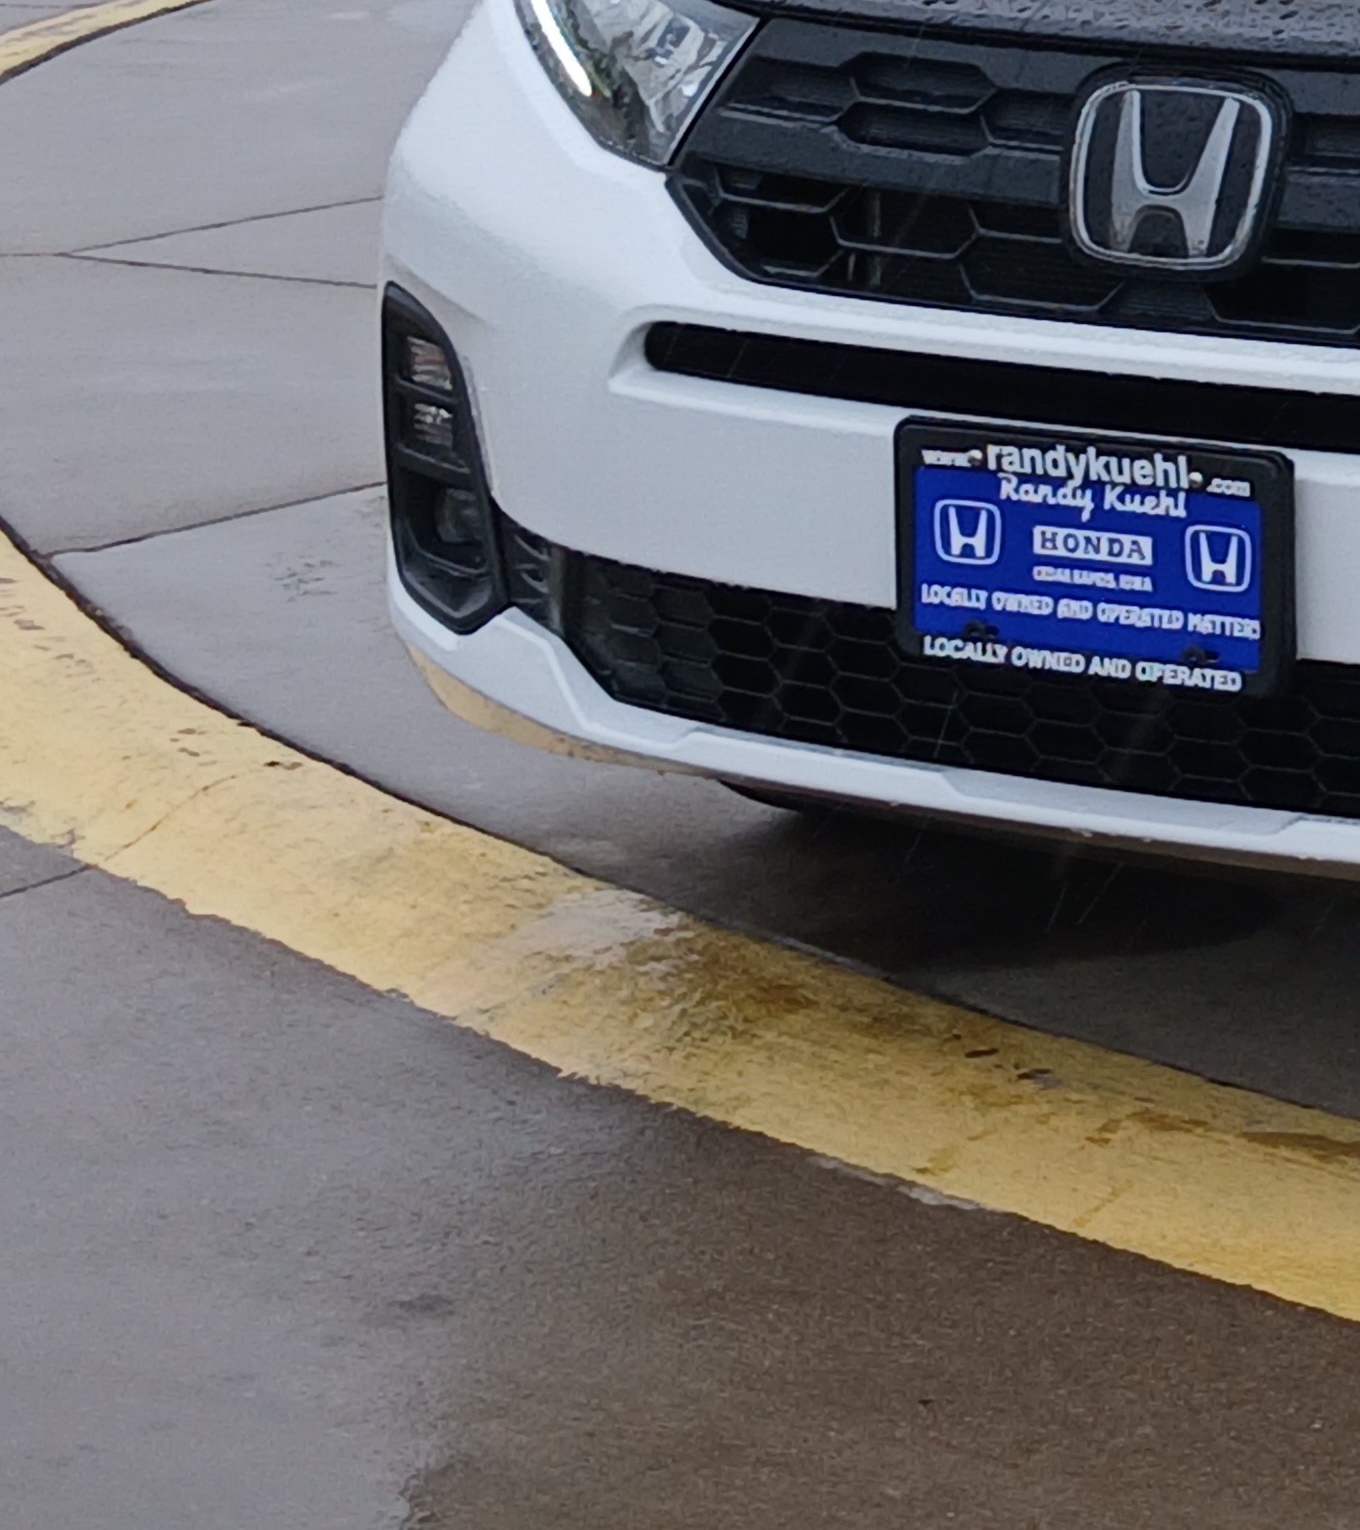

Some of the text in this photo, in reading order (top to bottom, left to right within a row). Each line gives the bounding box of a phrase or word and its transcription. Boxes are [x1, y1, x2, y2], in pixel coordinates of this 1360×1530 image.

[987, 444, 1189, 489] randykuehl
[997, 472, 1187, 522] Randy Kuehl
[1040, 530, 1146, 560] HONDA
[921, 583, 988, 610] LOCALLY
[991, 591, 1054, 616] OWNED
[1057, 598, 1093, 620] AND
[1096, 602, 1184, 630] OPERATED
[923, 635, 1242, 692] LOCALLY OWNED AND OPERATED
